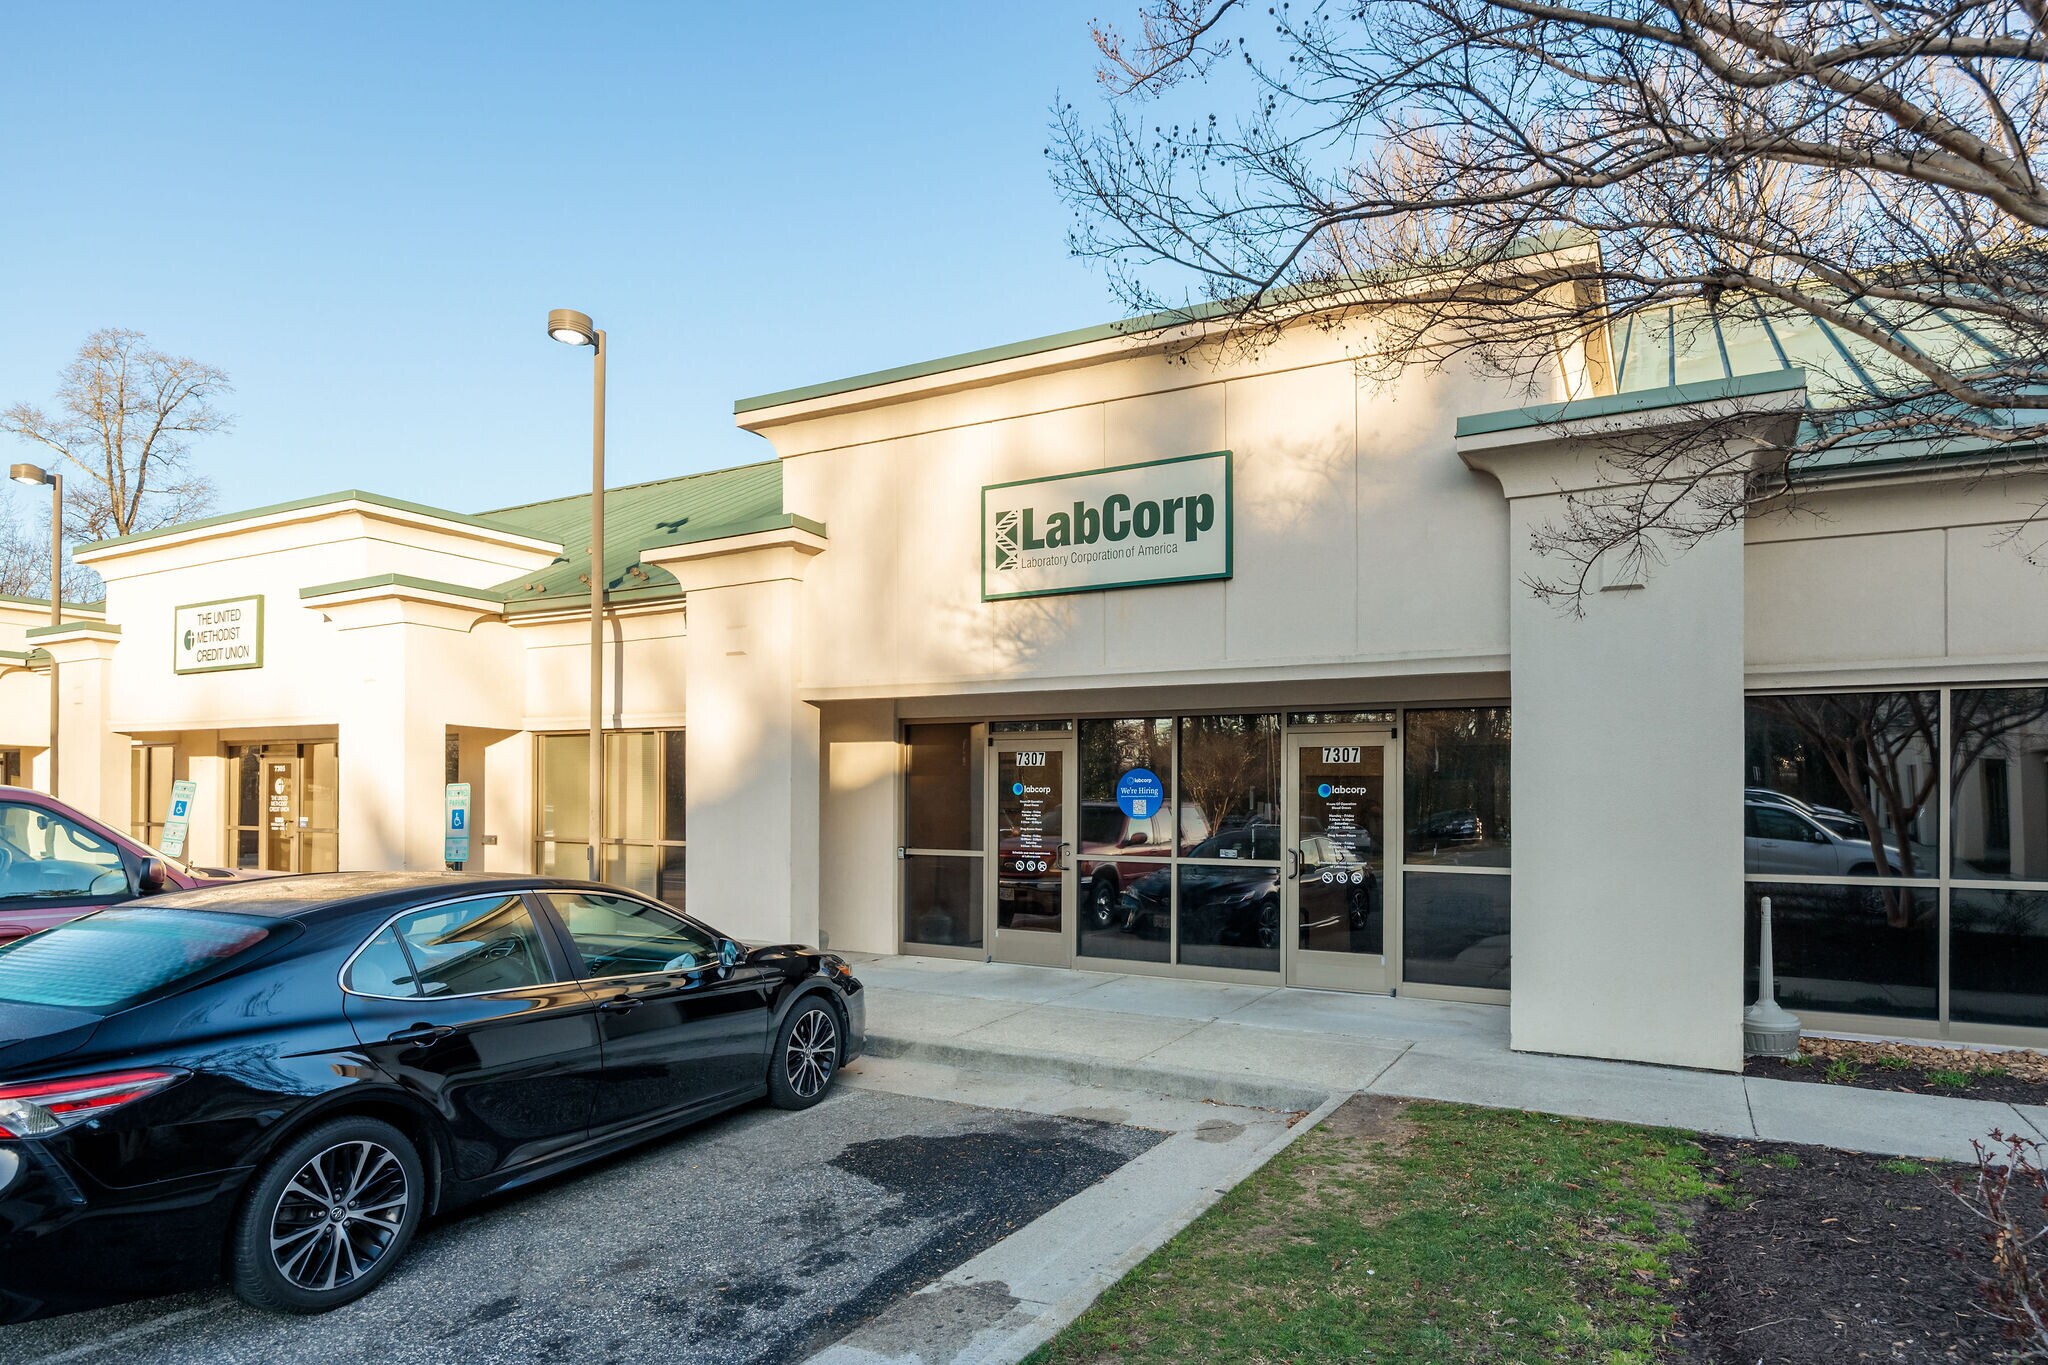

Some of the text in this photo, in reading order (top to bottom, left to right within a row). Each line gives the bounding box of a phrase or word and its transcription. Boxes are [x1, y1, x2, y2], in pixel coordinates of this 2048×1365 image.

[1022, 493, 1214, 551] LabCorp
[1021, 543, 1178, 569] Laboratory Corporation of America
[197, 608, 241, 625] THE UNITED
[196, 626, 240, 643] METHODIST
[196, 645, 250, 663] CREDIT UNION
[1017, 752, 1045, 766] 7307
[1324, 747, 1359, 763] 7307
[1024, 785, 1051, 795] labcorp
[1121, 786, 1159, 796] We're Hiring
[1332, 785, 1366, 796] labcorp
